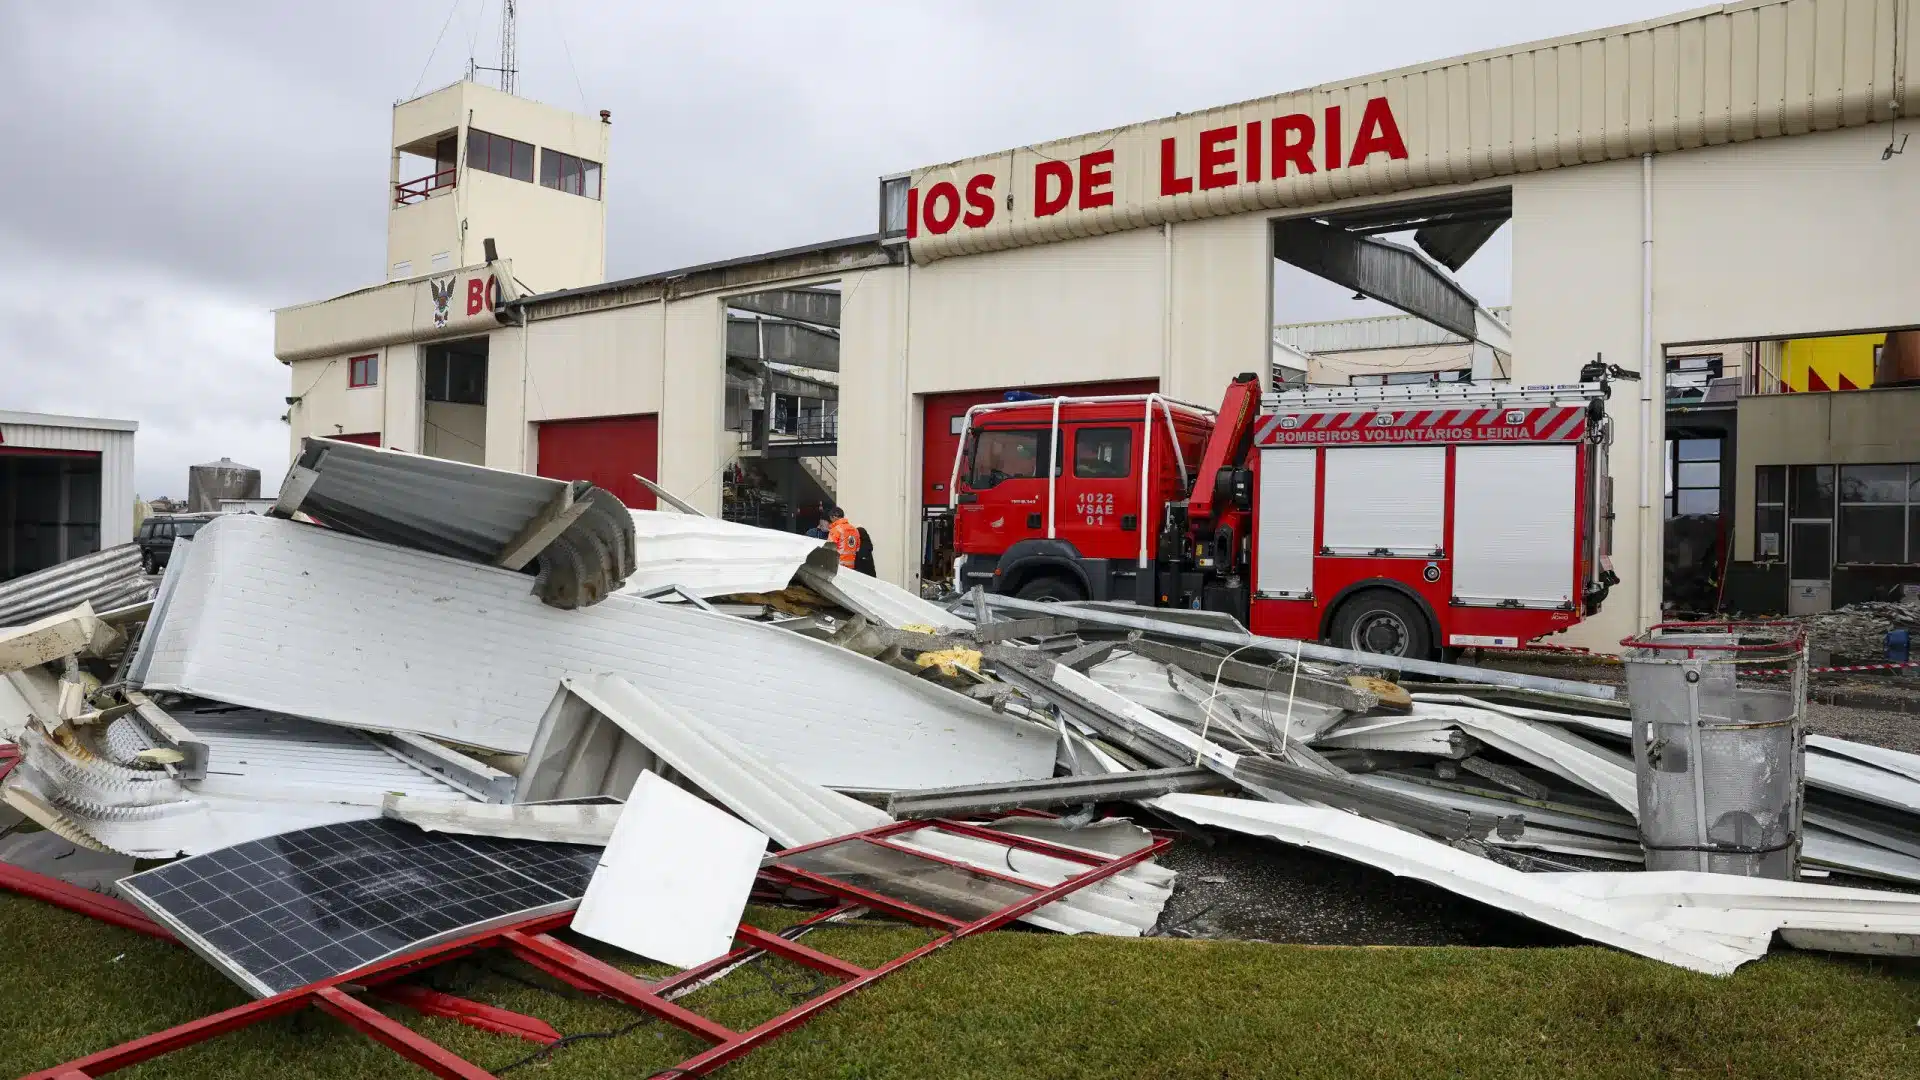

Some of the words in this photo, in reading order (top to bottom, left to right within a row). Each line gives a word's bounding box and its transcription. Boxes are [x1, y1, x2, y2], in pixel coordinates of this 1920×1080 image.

[906, 174, 995, 239] IOS
[1034, 149, 1114, 217] DE
[1160, 97, 1408, 196] LEIRIA
[1275, 430, 1360, 442] BOMBEIROS
[1365, 425, 1472, 440] VOLUNTÁRIOS
[1478, 427, 1530, 439] LEIRIA
[1079, 493, 1113, 503] 1022
[1076, 504, 1114, 514] VSAE
[1086, 516, 1103, 526] 01
